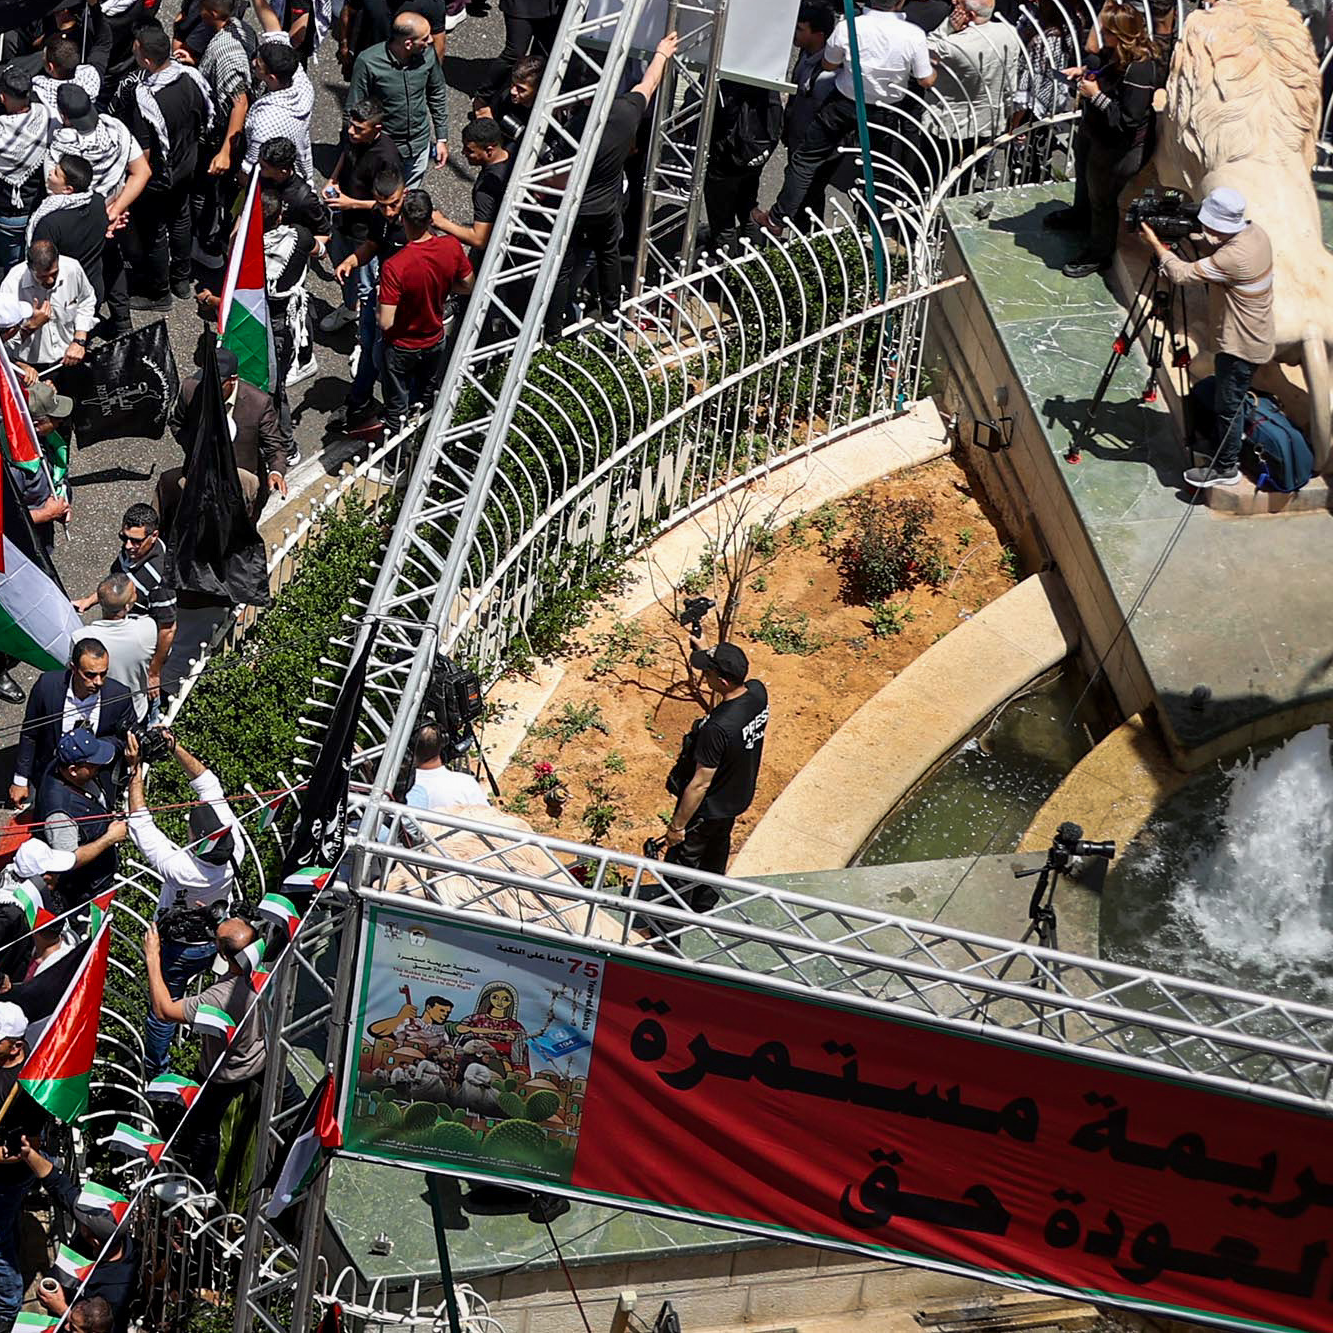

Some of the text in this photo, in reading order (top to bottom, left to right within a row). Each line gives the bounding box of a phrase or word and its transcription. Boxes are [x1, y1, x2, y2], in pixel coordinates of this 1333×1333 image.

[567, 957, 599, 979] 75
[629, 996, 1040, 1143] مستمرة
[839, 1146, 1333, 1303] لعودة حق
